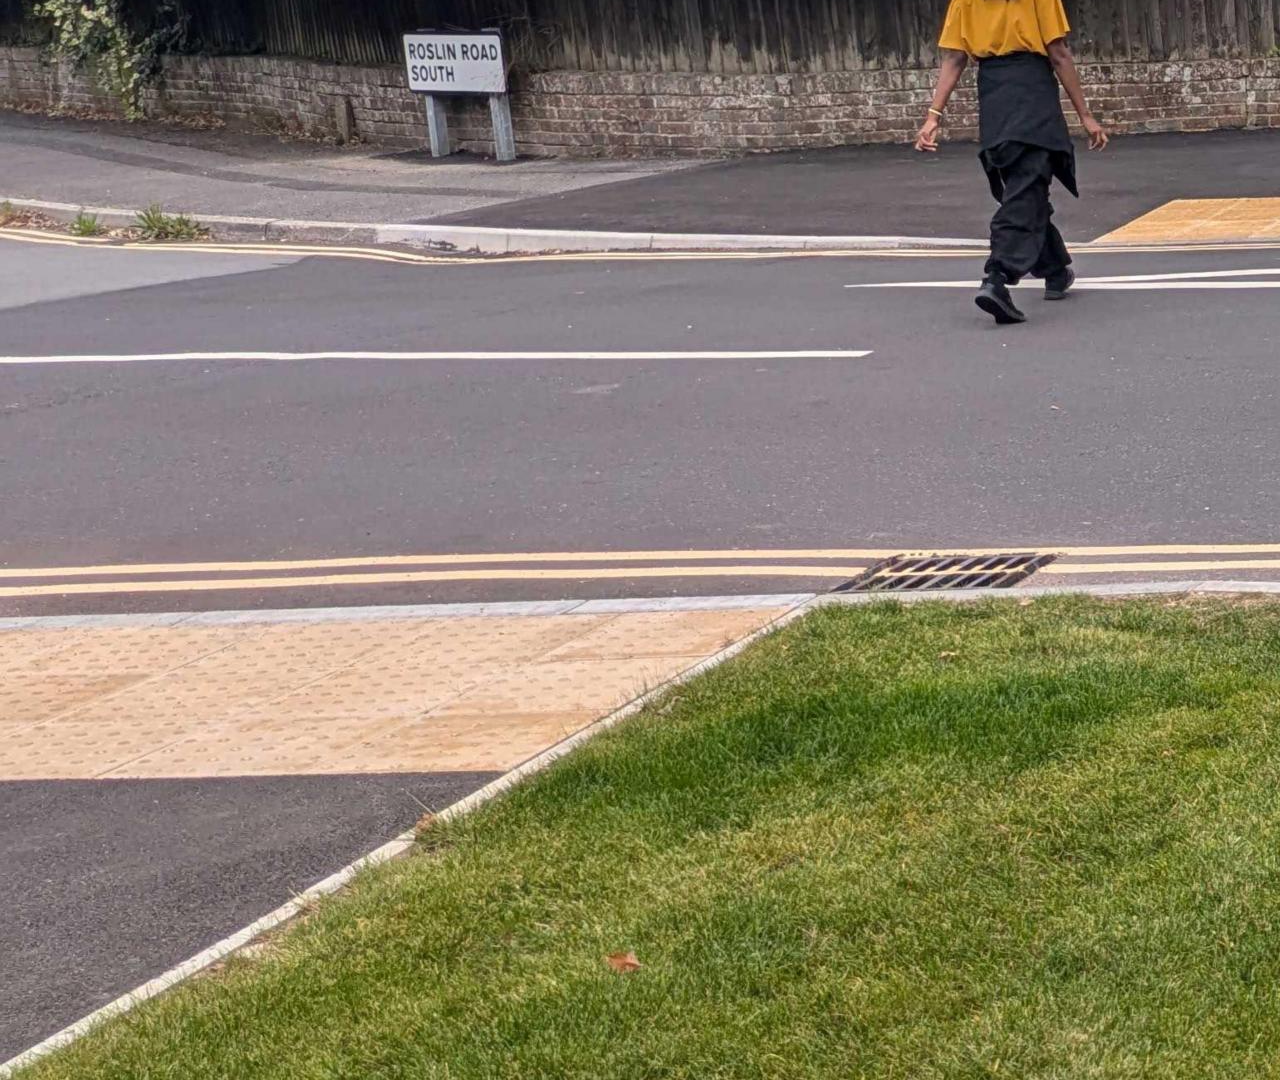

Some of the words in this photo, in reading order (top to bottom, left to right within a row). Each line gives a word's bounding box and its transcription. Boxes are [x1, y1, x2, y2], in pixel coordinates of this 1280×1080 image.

[408, 43, 457, 60] ROSLIN
[461, 43, 498, 61] ROAD
[411, 65, 455, 82] SOUTH
